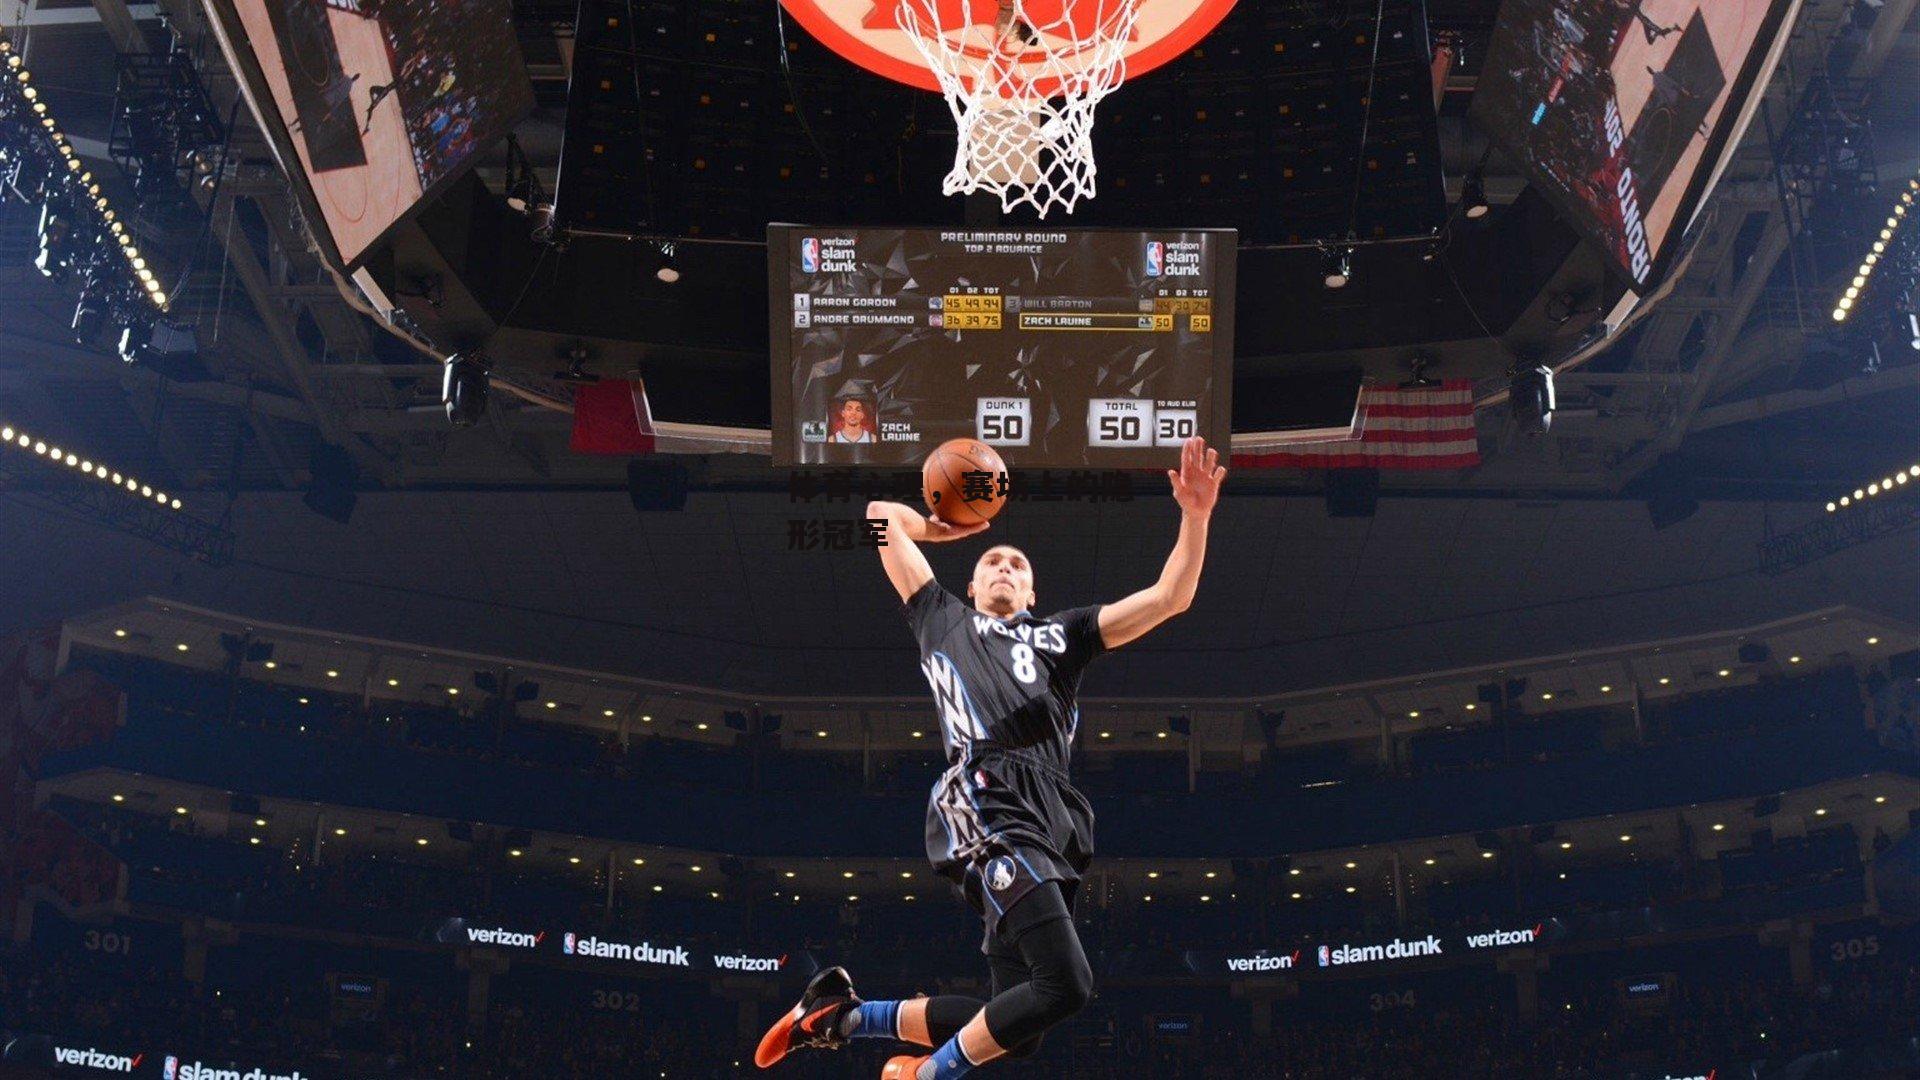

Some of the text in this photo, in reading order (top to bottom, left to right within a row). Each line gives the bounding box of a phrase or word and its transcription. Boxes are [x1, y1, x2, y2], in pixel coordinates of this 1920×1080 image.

[821, 237, 855, 246] verizon
[940, 232, 1067, 243] PRELIMINARY ROUND
[965, 244, 1043, 254] TOP 2 ADVANCE
[1165, 241, 1200, 250] verizon
[821, 246, 856, 259] slam
[1165, 250, 1200, 263] slam
[821, 259, 857, 272] dunk
[1164, 263, 1200, 276] dunk
[983, 286, 1000, 294] TOT
[813, 298, 850, 307] AARON
[852, 298, 897, 307] GORDON
[946, 299, 960, 308] 45
[965, 299, 980, 308] 49
[984, 299, 999, 308] 94
[1024, 299, 1048, 309] WILL
[1050, 300, 1092, 309] BARTON
[799, 314, 806, 325] 2
[813, 315, 850, 325] ANDRE
[852, 315, 915, 325] DRUMMOND
[966, 315, 980, 325] 39
[984, 316, 999, 326] 75
[1023, 316, 1053, 325] ZACH
[1156, 317, 1170, 327] 50
[1193, 318, 1208, 327] 50
[986, 401, 1015, 410] DUNK
[1106, 403, 1138, 411] TOTAL
[881, 423, 911, 432] ZACH
[983, 415, 1023, 440] 50
[1100, 416, 1141, 441] 50
[1159, 419, 1193, 439] 30
[881, 433, 920, 441] LAVINE
[1010, 643, 1037, 684] 8
[84, 929, 132, 956] 301
[467, 928, 535, 948] verizon
[1466, 927, 1535, 949] verizon
[576, 936, 690, 967] slam dunk
[1331, 934, 1443, 965] slam dunk
[1830, 935, 1880, 962] 305
[714, 953, 779, 972] verizon
[1227, 953, 1293, 972] verizon
[341, 983, 372, 993] verizon
[1628, 982, 1660, 994] verizon
[592, 989, 641, 1011] 302
[54, 1046, 133, 1073] verizon
[178, 1061, 241, 1080] slam
